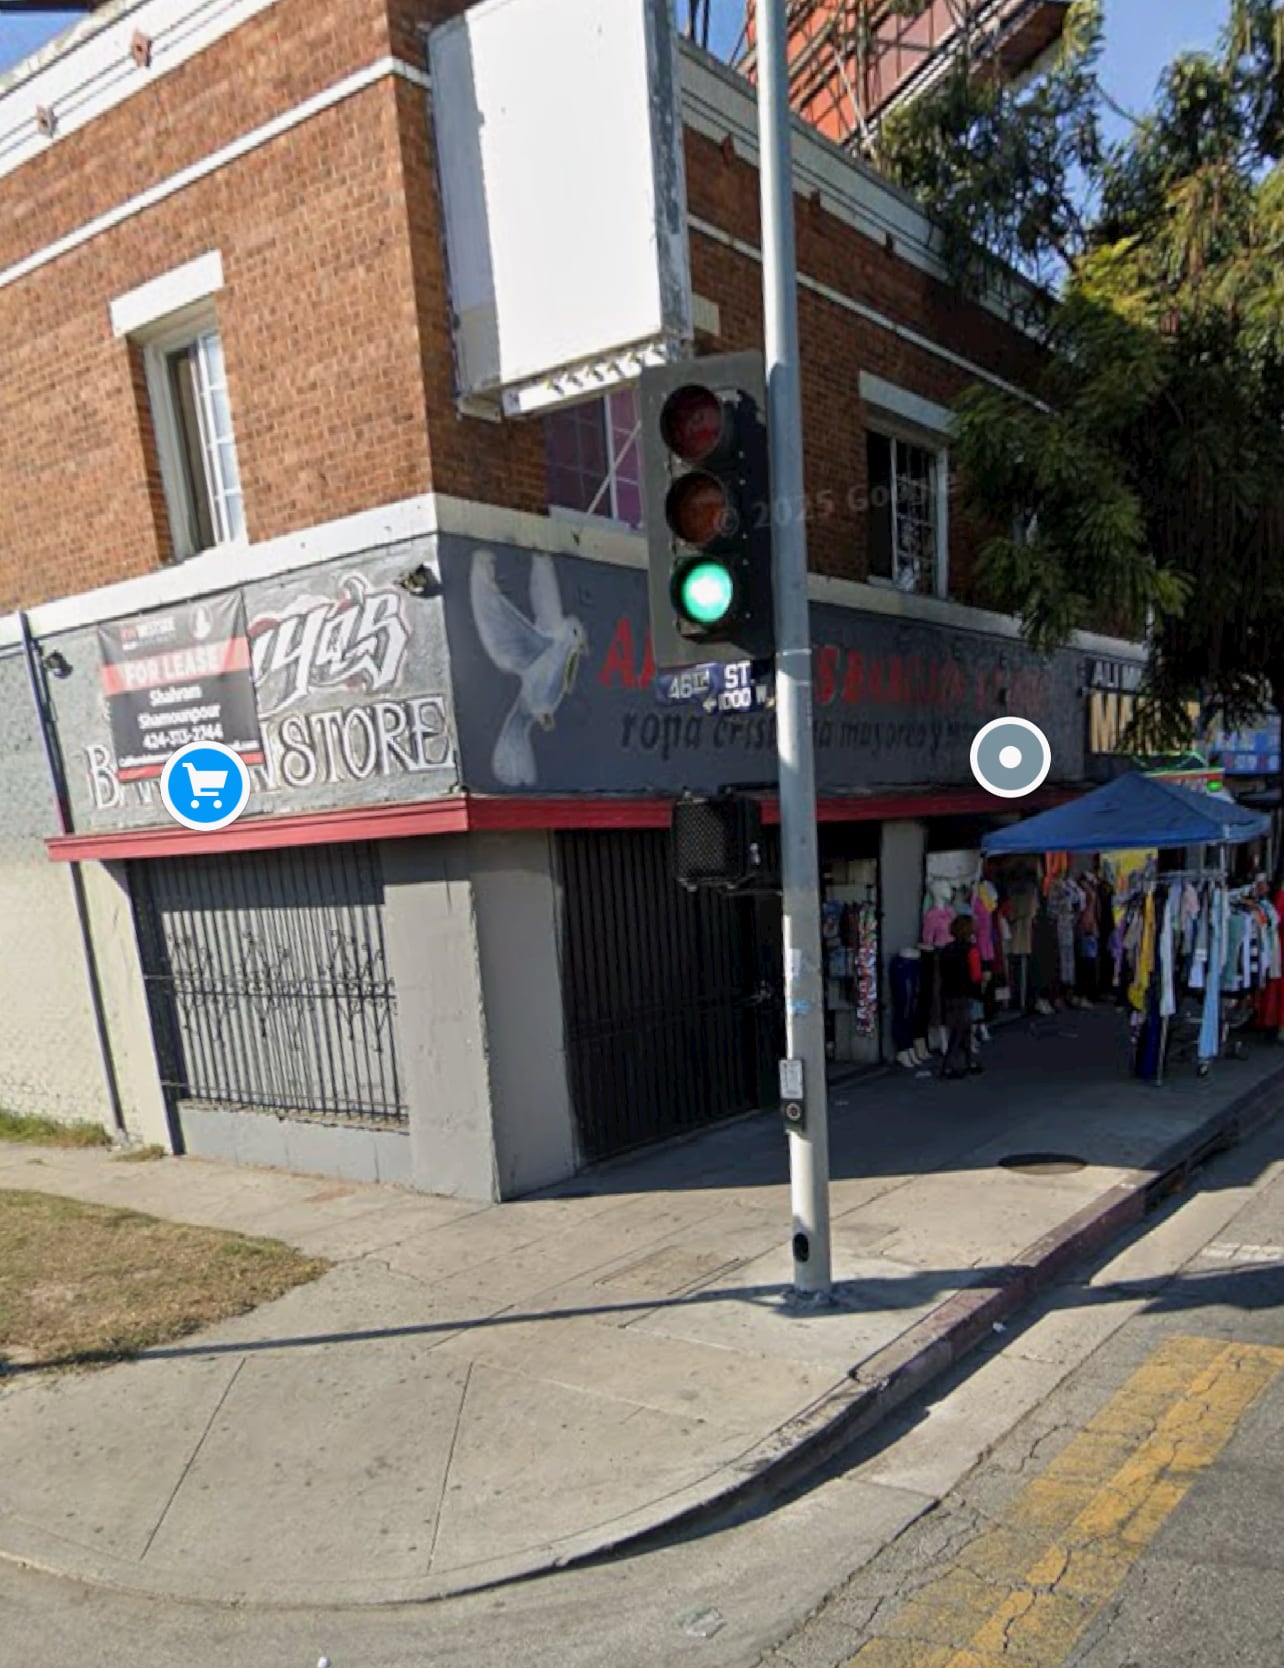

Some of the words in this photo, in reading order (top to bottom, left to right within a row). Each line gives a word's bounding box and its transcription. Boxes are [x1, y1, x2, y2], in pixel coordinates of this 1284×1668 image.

[125, 658, 160, 687] FOR
[163, 644, 220, 679] LEASE
[668, 669, 709, 700] 46TH
[281, 696, 454, 786] STORE
[621, 711, 702, 760] ropa
